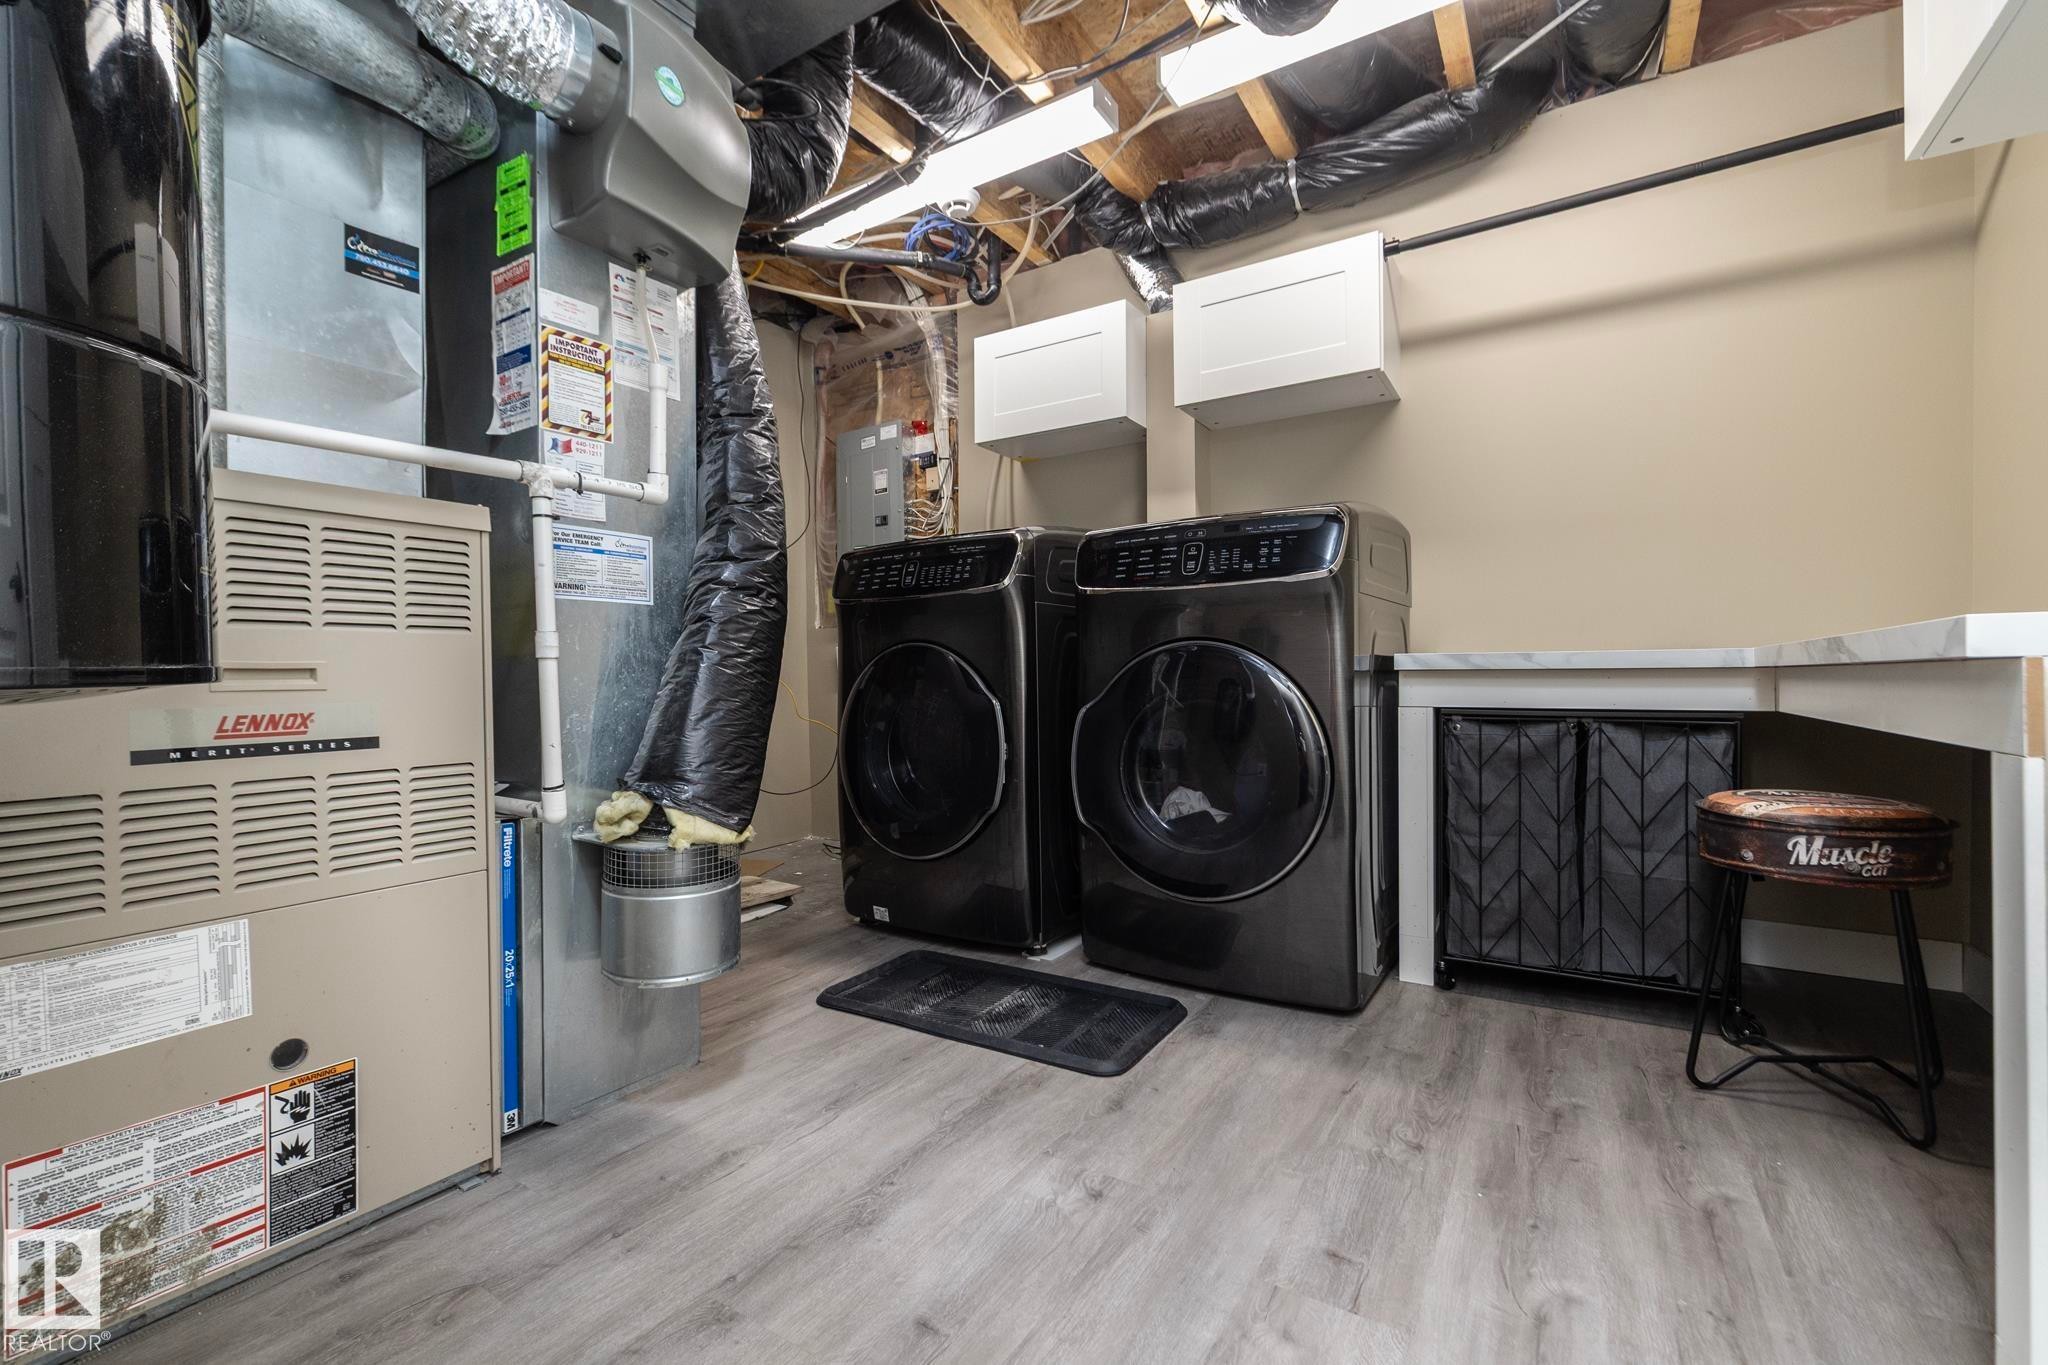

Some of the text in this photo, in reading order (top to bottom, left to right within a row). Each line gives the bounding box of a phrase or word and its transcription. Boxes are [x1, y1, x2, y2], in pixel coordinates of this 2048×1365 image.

[550, 344, 603, 365] INSTRUCTIONS
[555, 338, 598, 357] IMPORTANT
[572, 532, 604, 541] EMERGENCY
[272, 741, 352, 754] SERIES
[503, 827, 513, 868] Filtrete
[1786, 834, 1895, 867] Muscle
[148, 934, 178, 944] FURNACE
[504, 949, 515, 988] 20x25x1
[297, 1067, 337, 1084] WARNING
[68, 1103, 216, 1152] FOR YOUR SAFETY READ BEFORE OPERATING
[506, 1112, 516, 1130] 3M
